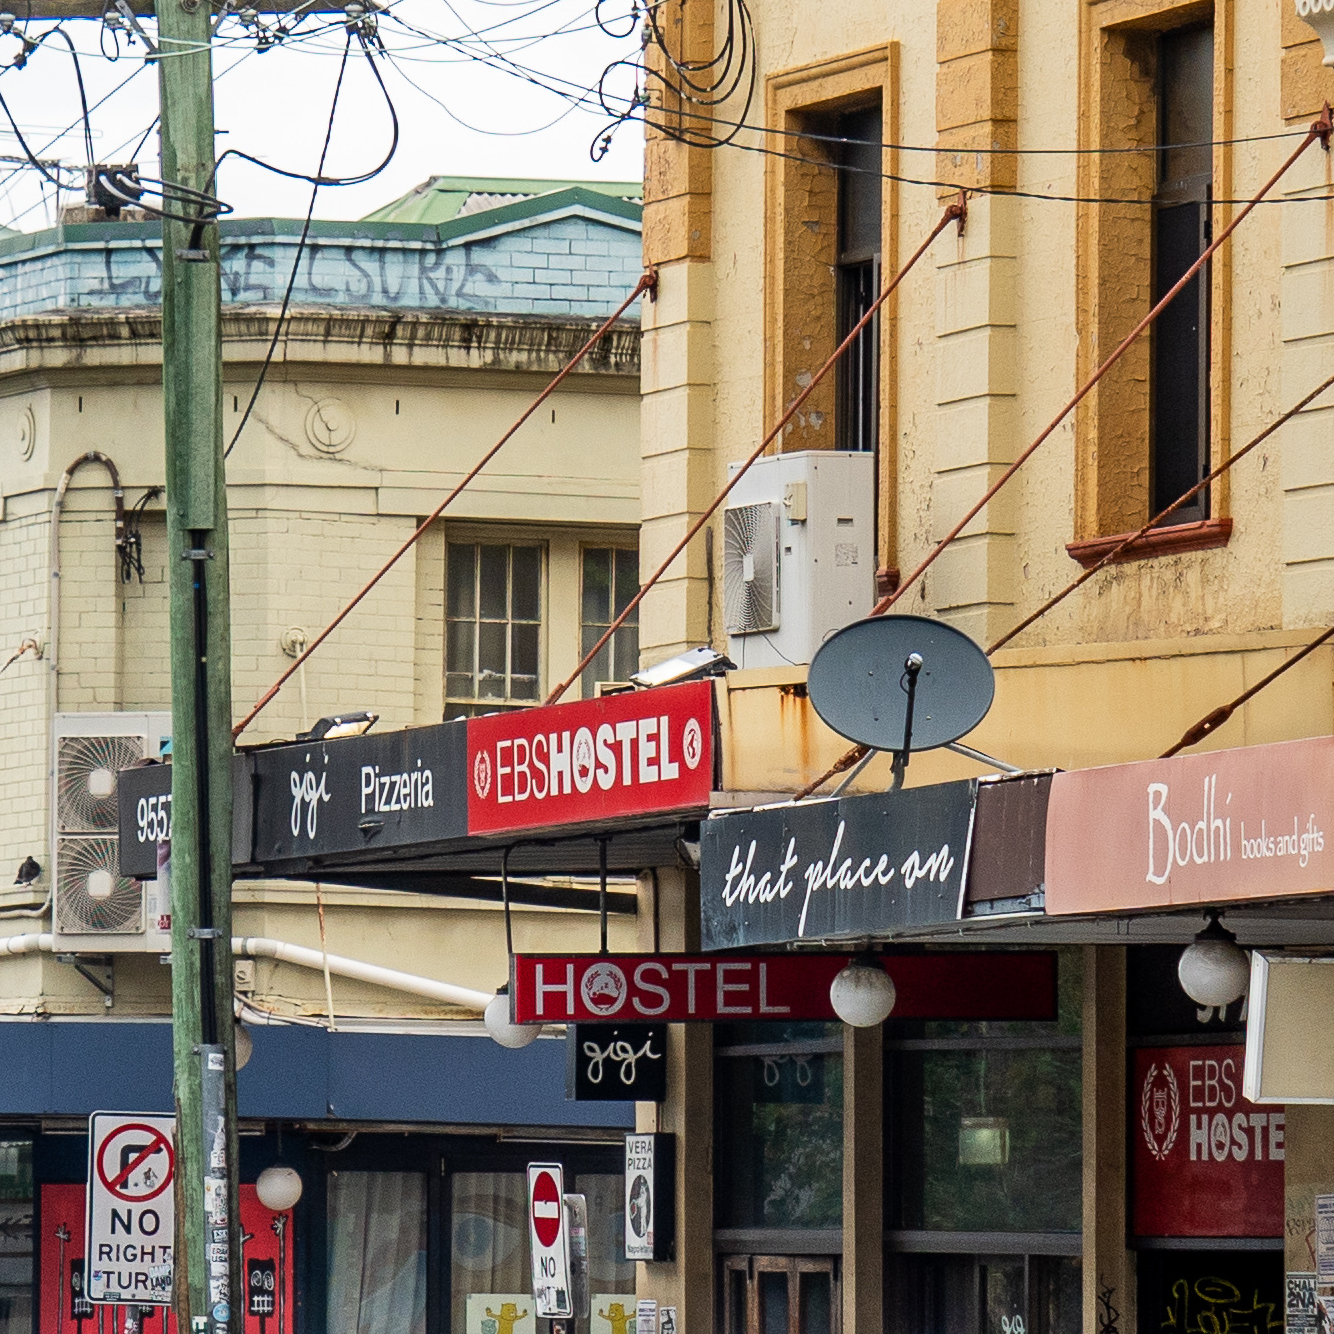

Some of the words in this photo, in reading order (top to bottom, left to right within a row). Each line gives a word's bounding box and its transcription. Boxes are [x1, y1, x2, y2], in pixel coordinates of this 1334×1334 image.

[136, 793, 172, 843] 955
[290, 752, 332, 840] gigi
[360, 758, 434, 815] Pizzeria
[1145, 773, 1232, 885] Bodhi
[1240, 818, 1275, 860] books
[1276, 815, 1299, 857] and
[1299, 813, 1325, 868] gifts
[722, 836, 798, 908] that
[803, 819, 895, 938] place
[900, 843, 955, 889] on
[535, 961, 791, 1016] HOSTEL
[582, 1030, 662, 1085] gigi
[1189, 1058, 1237, 1108] EBS
[627, 1140, 653, 1155] VERA
[1189, 1112, 1286, 1162] HOSTE
[627, 1157, 652, 1171] PIZZA
[110, 1207, 160, 1236] NO
[98, 1243, 172, 1264] RIGHT
[539, 1256, 557, 1279] NO
[102, 1270, 150, 1291] TUR
